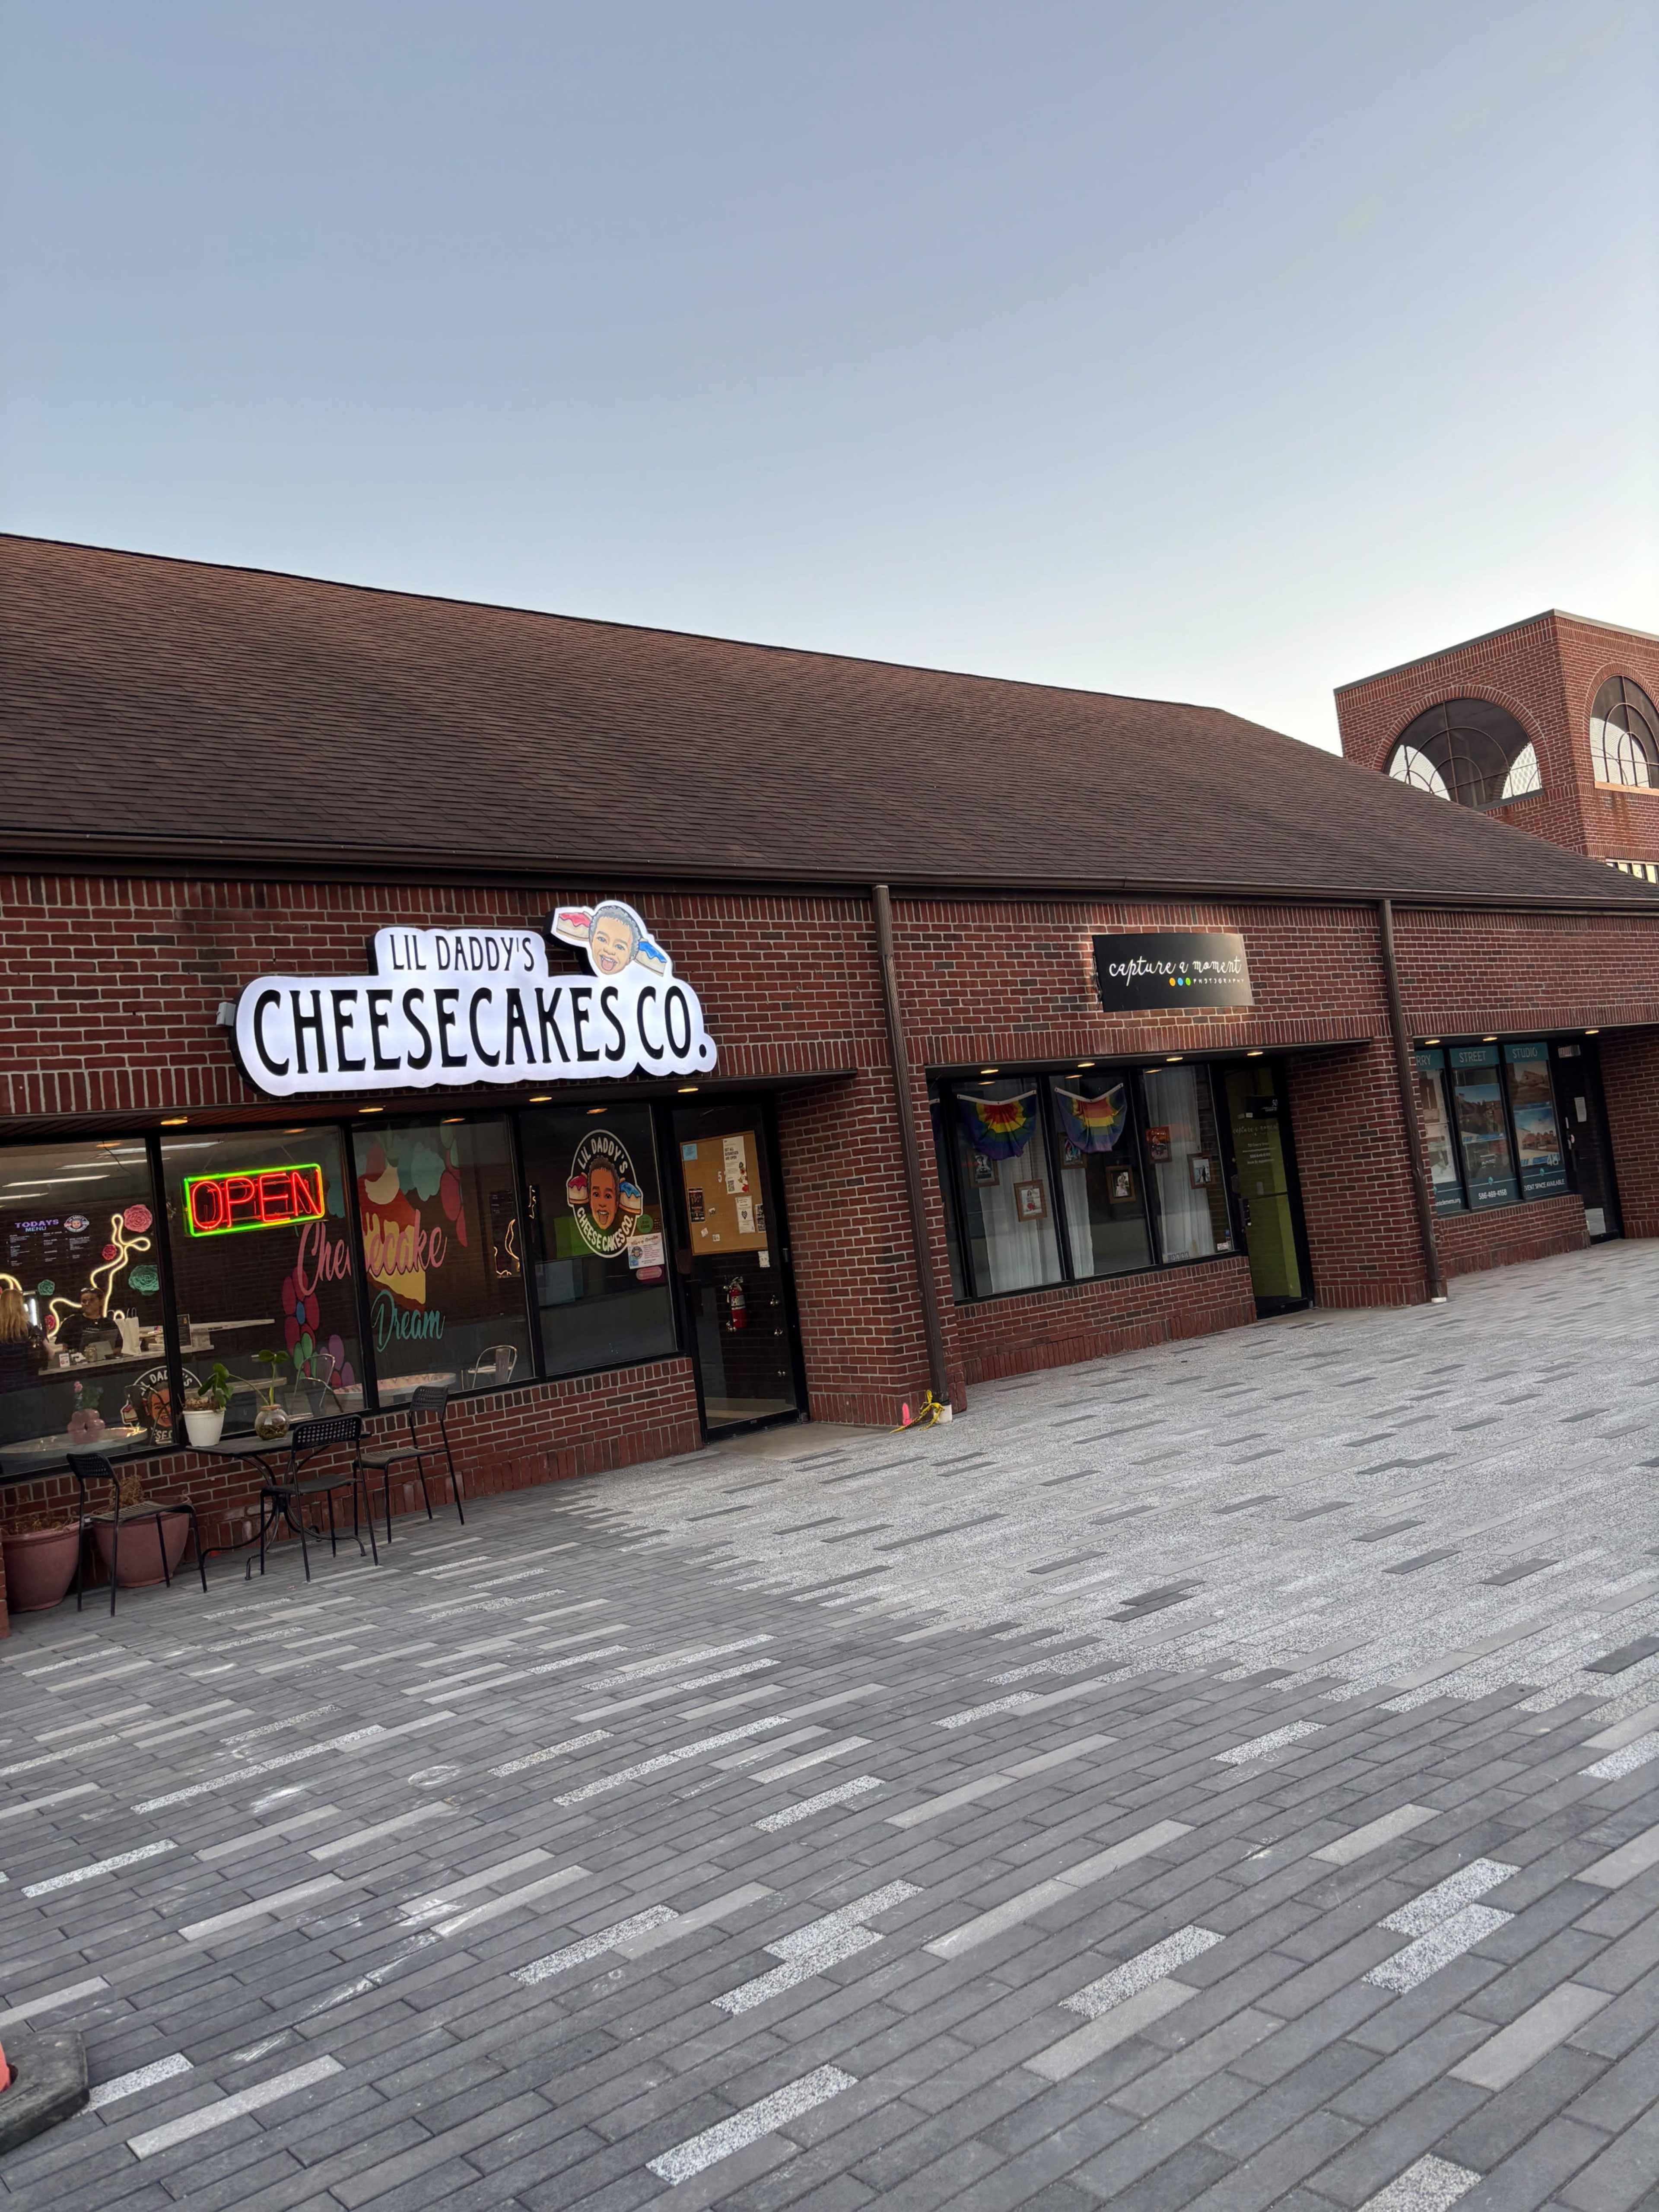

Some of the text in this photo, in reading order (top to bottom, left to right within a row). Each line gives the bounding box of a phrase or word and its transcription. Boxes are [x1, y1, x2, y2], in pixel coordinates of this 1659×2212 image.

[390, 934, 534, 972] LIL DADDY'S
[1109, 955, 1242, 987] capture a moment
[253, 985, 708, 1076] CHEESECAKES CO.
[1416, 1047, 1538, 1066] RRY STREET STUDIO
[578, 1137, 628, 1174] LIL DADDY'S
[191, 1168, 324, 1230] OPEN
[14, 1219, 59, 1229] TODAYS
[622, 1215, 633, 1235] CO.
[371, 1289, 445, 1352] Dream
